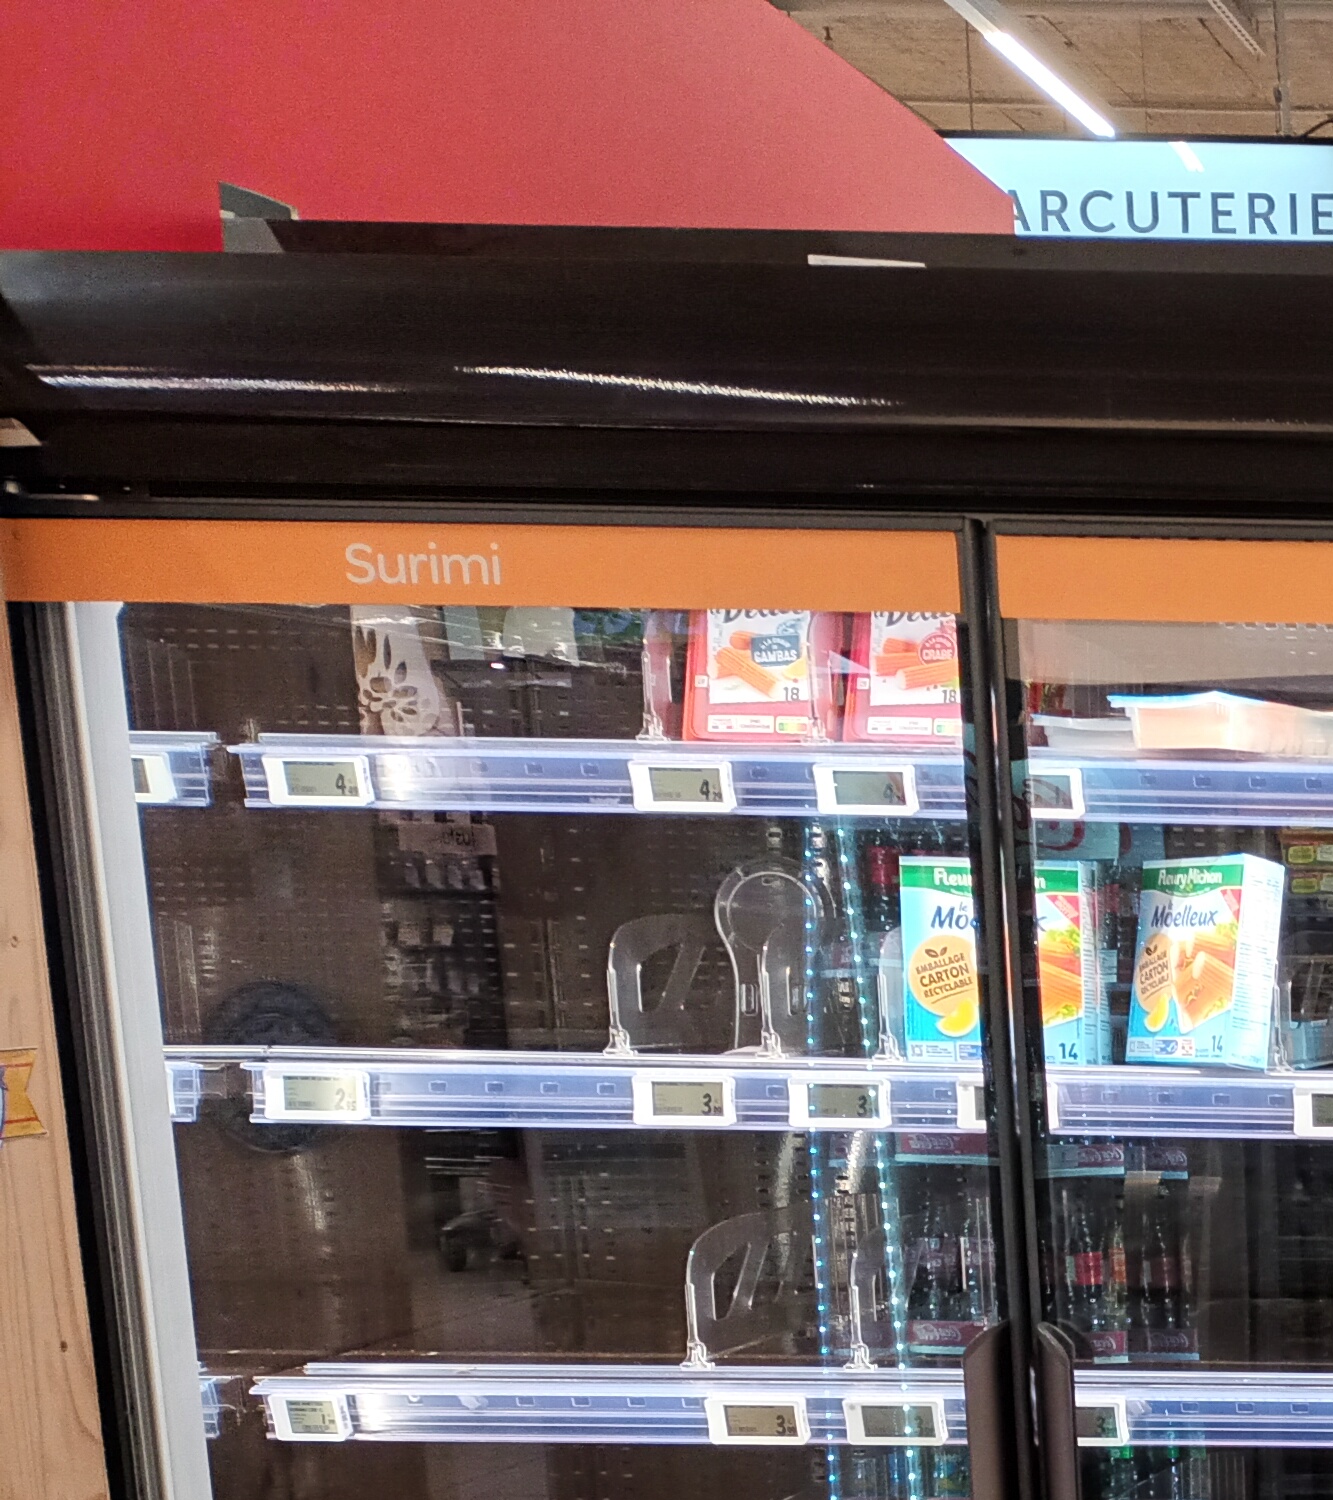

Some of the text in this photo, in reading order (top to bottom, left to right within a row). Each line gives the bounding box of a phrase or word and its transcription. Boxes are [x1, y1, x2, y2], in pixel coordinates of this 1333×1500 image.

[344, 543, 501, 586] Surimi
[783, 686, 800, 701] 18
[942, 687, 957, 703] 18
[1150, 904, 1219, 928] Moelleux
[915, 951, 965, 975] EMBALLAGE
[919, 962, 969, 988] CARTON
[923, 975, 973, 998] RECYCLABLE
[1058, 1042, 1078, 1061] 14
[1211, 1034, 1223, 1053] 14
